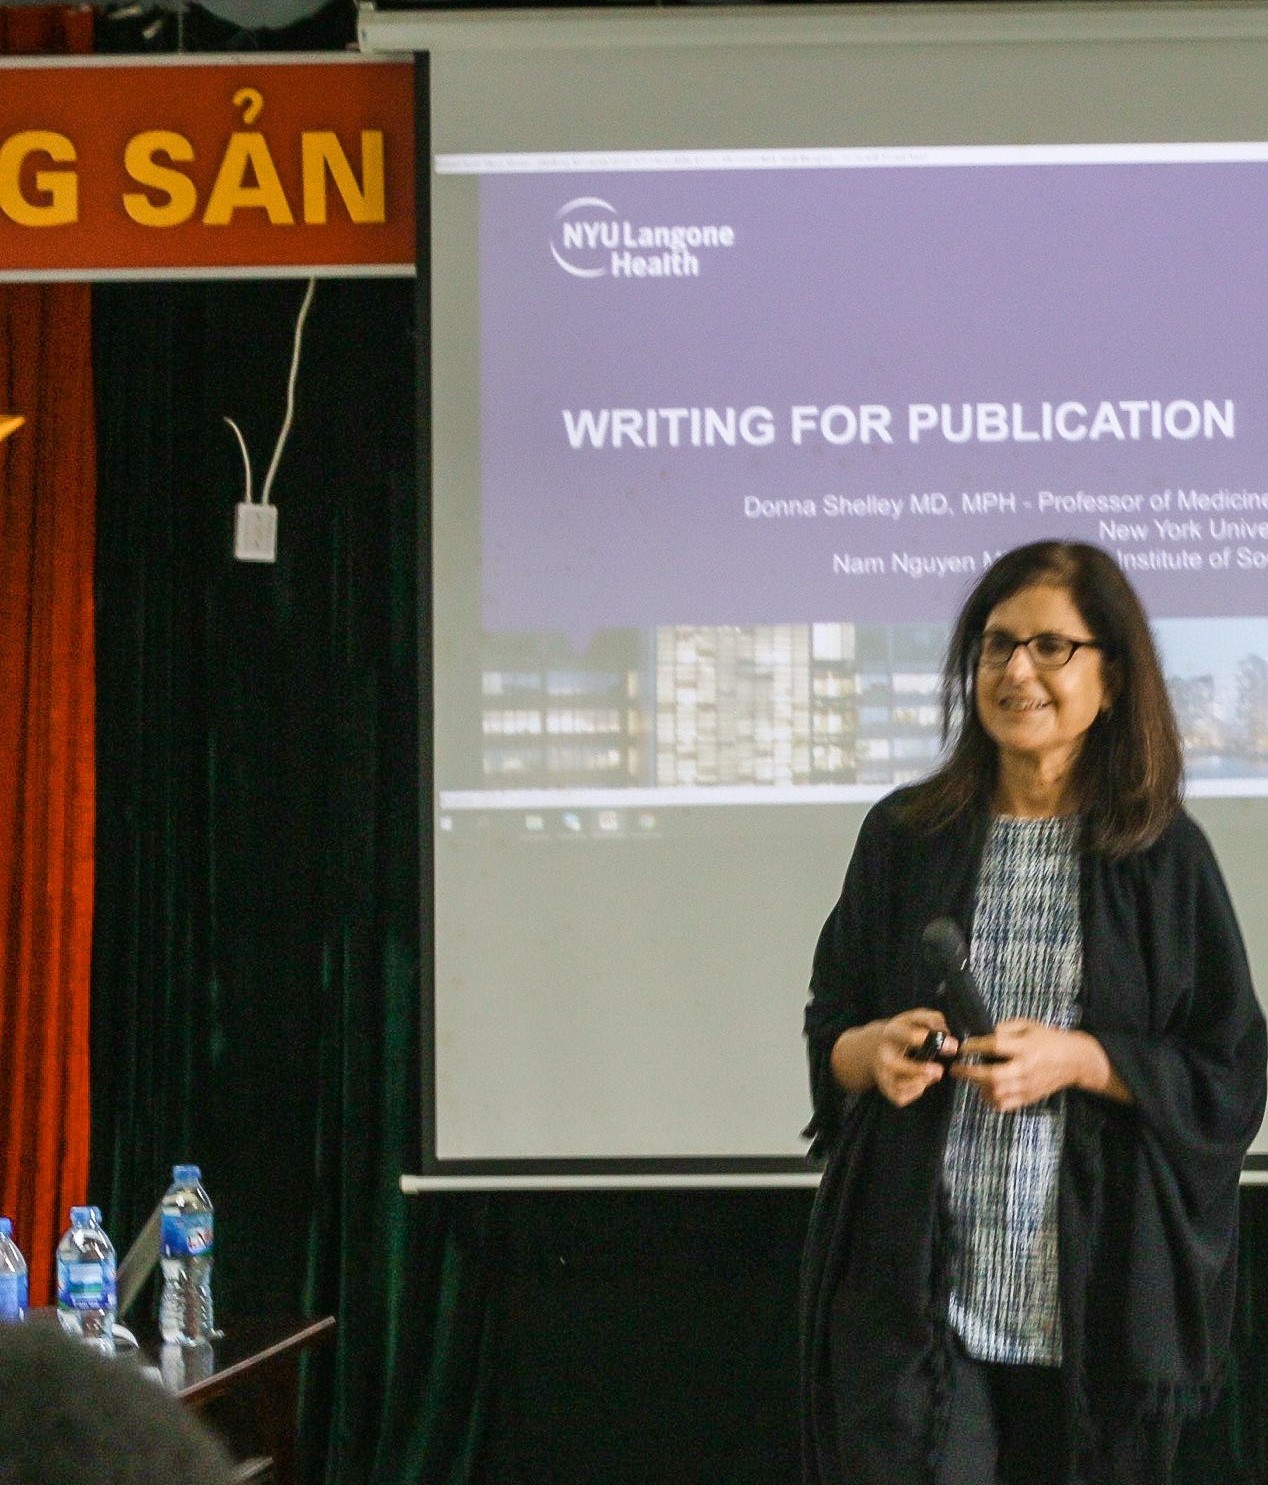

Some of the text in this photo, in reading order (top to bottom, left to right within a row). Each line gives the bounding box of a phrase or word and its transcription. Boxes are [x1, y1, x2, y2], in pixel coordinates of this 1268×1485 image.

[0, 87, 386, 227] G SẢN
[562, 220, 735, 254] NYU Langone
[610, 249, 700, 278] Health
[562, 399, 1235, 449] WRITING FOR PUBLICATION
[744, 495, 817, 518] Donna
[822, 493, 901, 521] Shelley
[910, 492, 954, 517] MD,
[961, 491, 1016, 514] MPH
[1038, 489, 1144, 513] Professor
[1149, 488, 1173, 512] of
[1099, 519, 1149, 541] New
[1153, 518, 1202, 541] York
[832, 554, 884, 576] Nam
[892, 551, 975, 578] Nguyen
[1116, 548, 1203, 571] Institute
[1208, 546, 1232, 569] of
